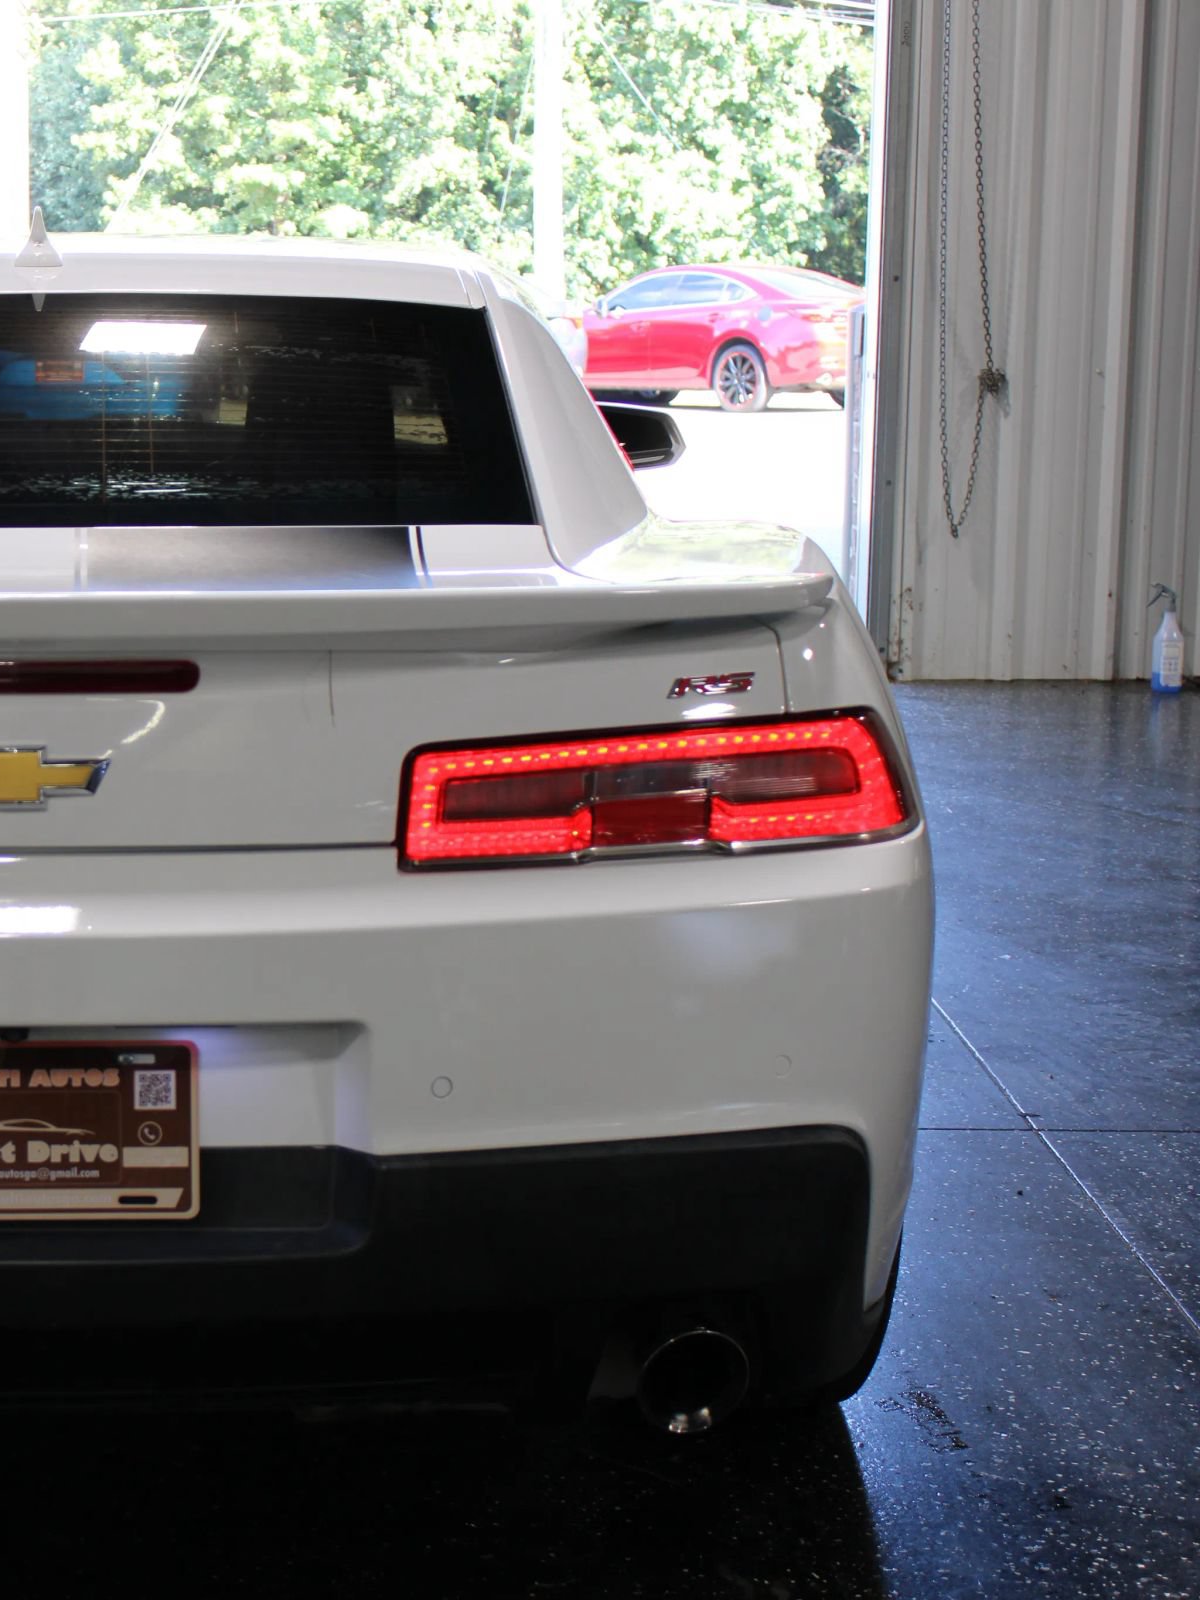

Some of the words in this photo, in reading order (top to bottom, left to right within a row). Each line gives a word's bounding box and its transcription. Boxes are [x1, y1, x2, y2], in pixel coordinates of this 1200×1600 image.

[666, 672, 755, 699] RS
[28, 1069, 120, 1087] AUTOS
[27, 1140, 119, 1163] Drive
